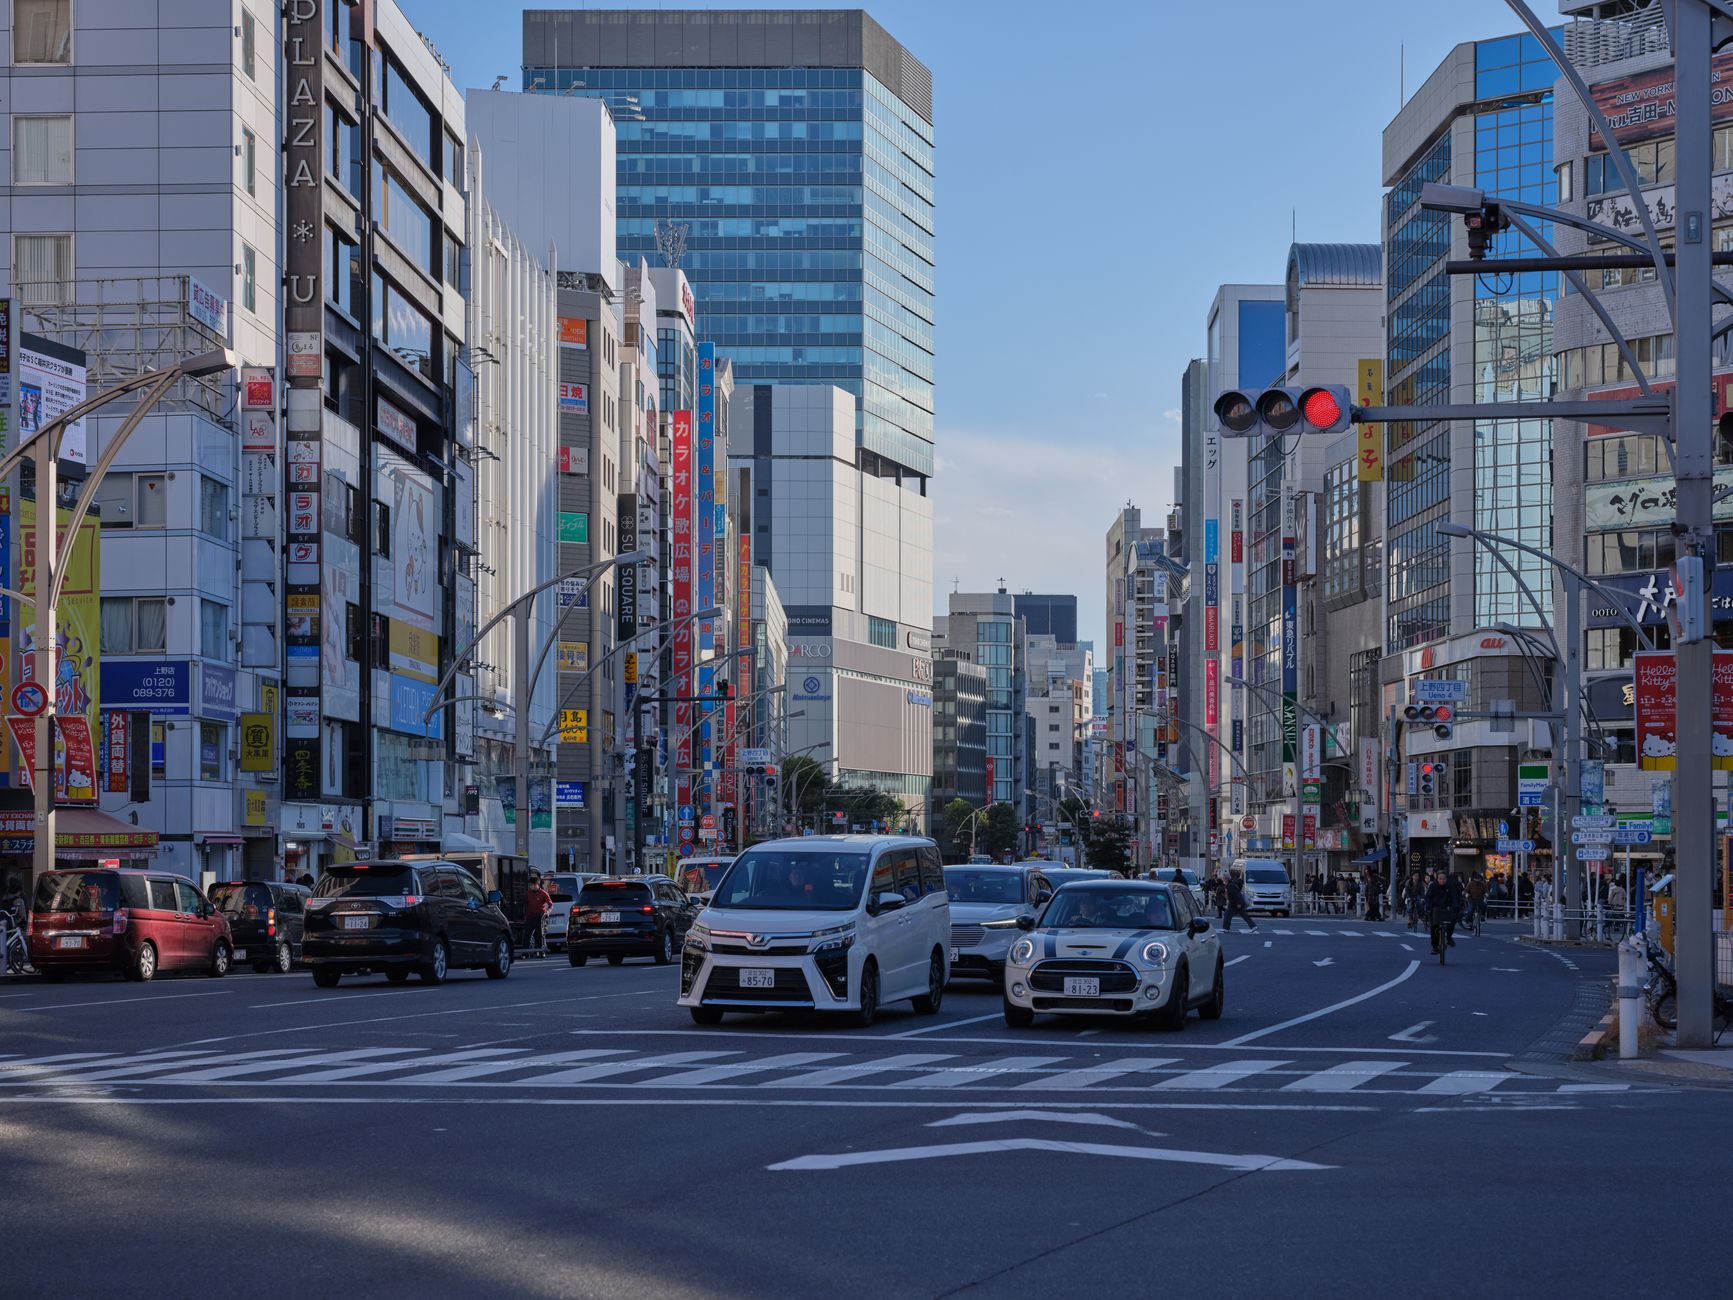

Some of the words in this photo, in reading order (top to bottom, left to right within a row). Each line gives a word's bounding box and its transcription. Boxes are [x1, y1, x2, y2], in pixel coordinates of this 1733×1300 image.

[290, 0, 317, 187] PLAZA
[1616, 92, 1641, 105] NEW
[1644, 84, 1672, 99] YORK
[290, 275, 317, 302] U
[1206, 437, 1217, 470] エッグ
[675, 421, 689, 583] カラオケ歌広場
[622, 567, 633, 624] SQUARE
[1285, 620, 1294, 669] 東急リバブル
[1480, 638, 1506, 649] au
[154, 667, 175, 675] 上野店
[1640, 665, 1676, 676] Hello
[142, 677, 175, 687] (0120)
[1420, 682, 1462, 692] 上野四丁目
[1641, 675, 1670, 691] Kitty
[133, 688, 175, 698] 089-376
[1428, 691, 1447, 699] Ueno
[111, 713, 125, 774] 外貨両替
[683, 830, 691, 838] 50
[747, 976, 773, 986] 85-70
[1071, 985, 1098, 995] 81-23
